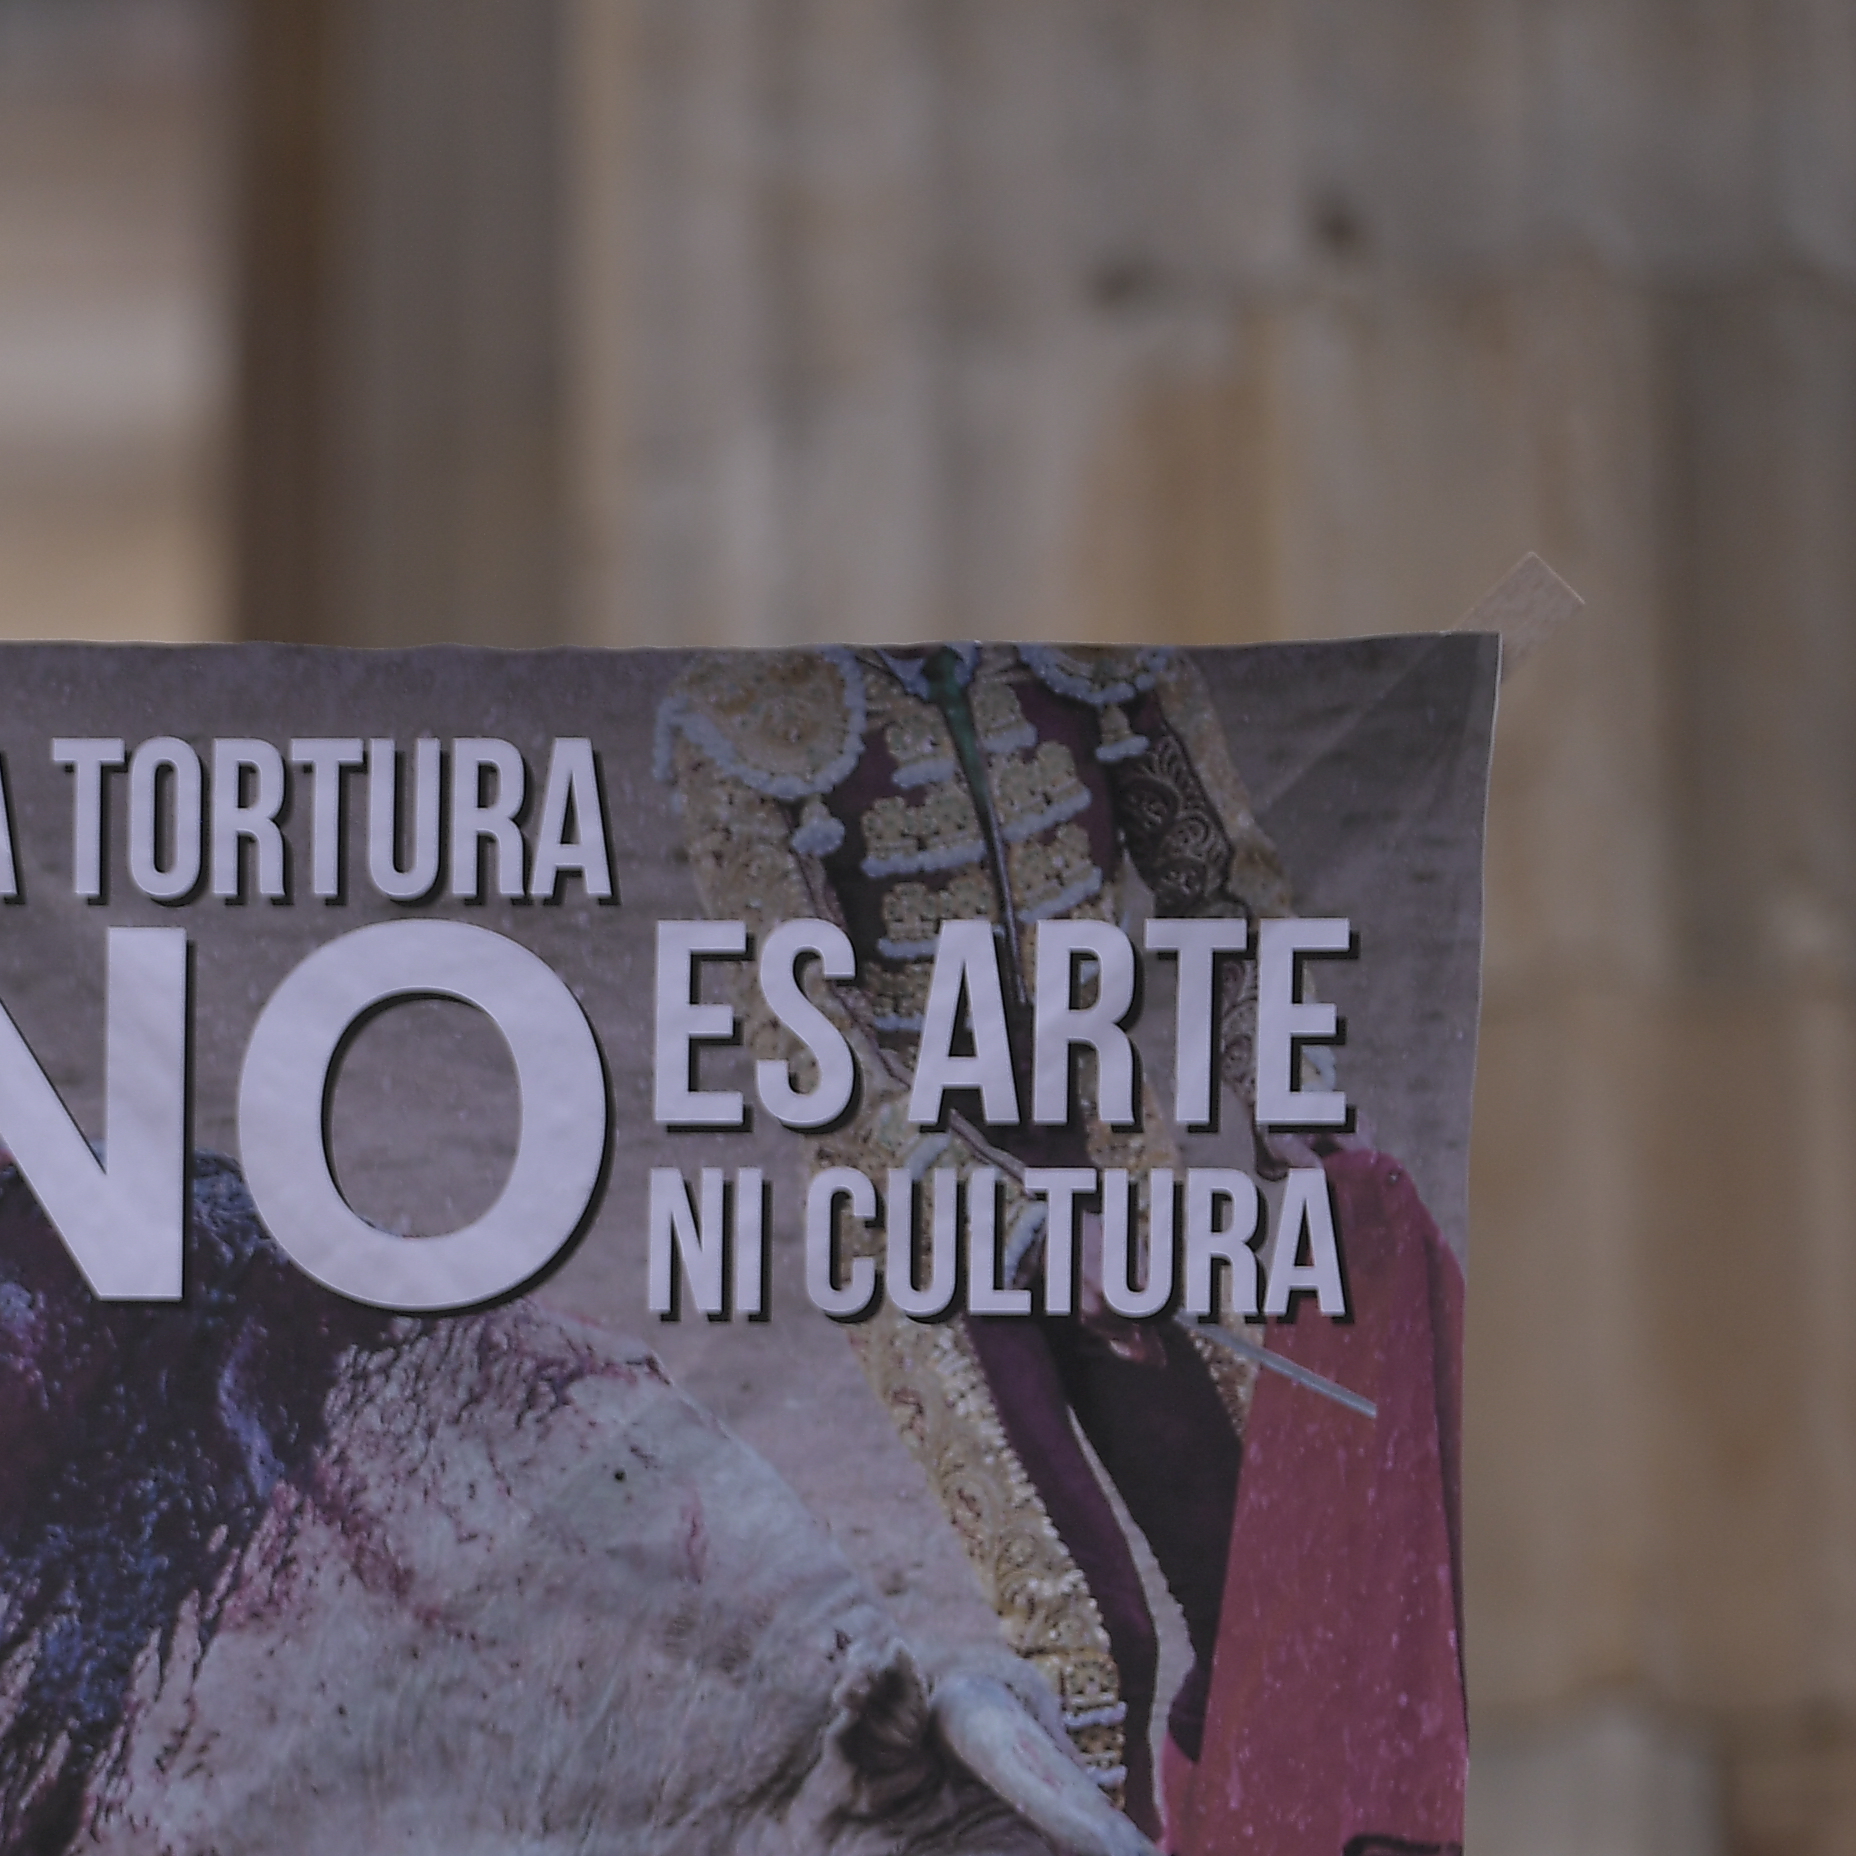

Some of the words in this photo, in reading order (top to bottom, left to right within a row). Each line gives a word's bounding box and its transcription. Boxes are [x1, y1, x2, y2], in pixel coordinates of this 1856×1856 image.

[52, 737, 613, 901] TORTURA
[654, 918, 856, 1130] ES
[910, 916, 1352, 1125] ARTE
[647, 1171, 763, 1315] NI
[804, 1166, 1346, 1318] CULTURA
